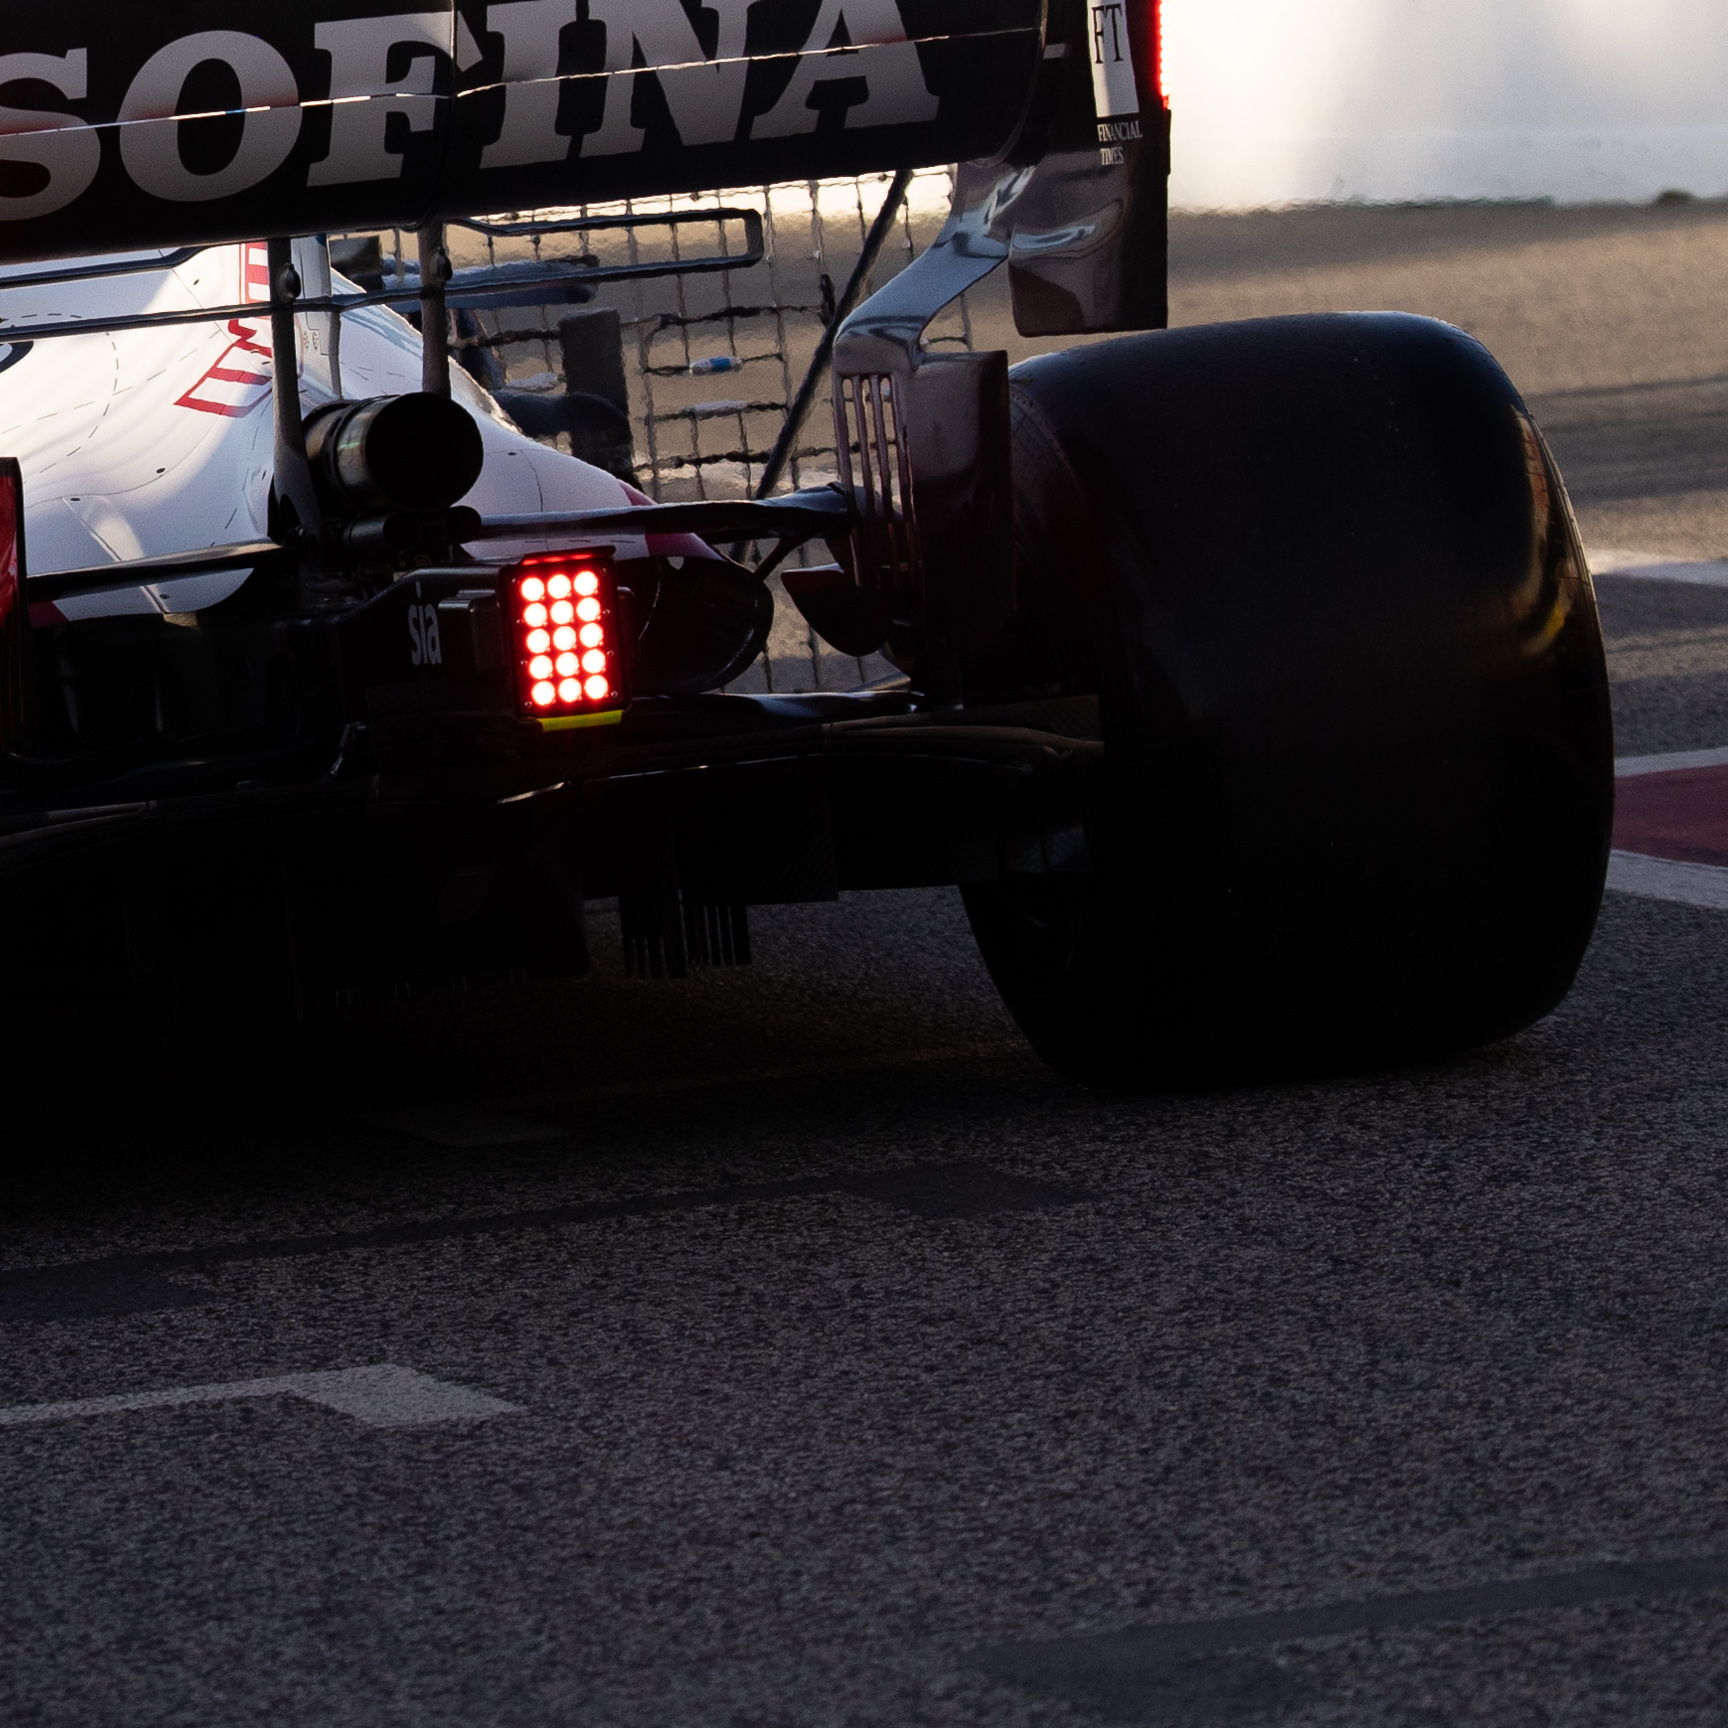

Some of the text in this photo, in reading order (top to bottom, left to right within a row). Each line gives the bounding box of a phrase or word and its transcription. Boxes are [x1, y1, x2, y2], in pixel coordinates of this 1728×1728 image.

[1091, 3, 1124, 64] FT
[1097, 121, 1143, 142] FINANCIAL
[1100, 147, 1124, 165] TIMES
